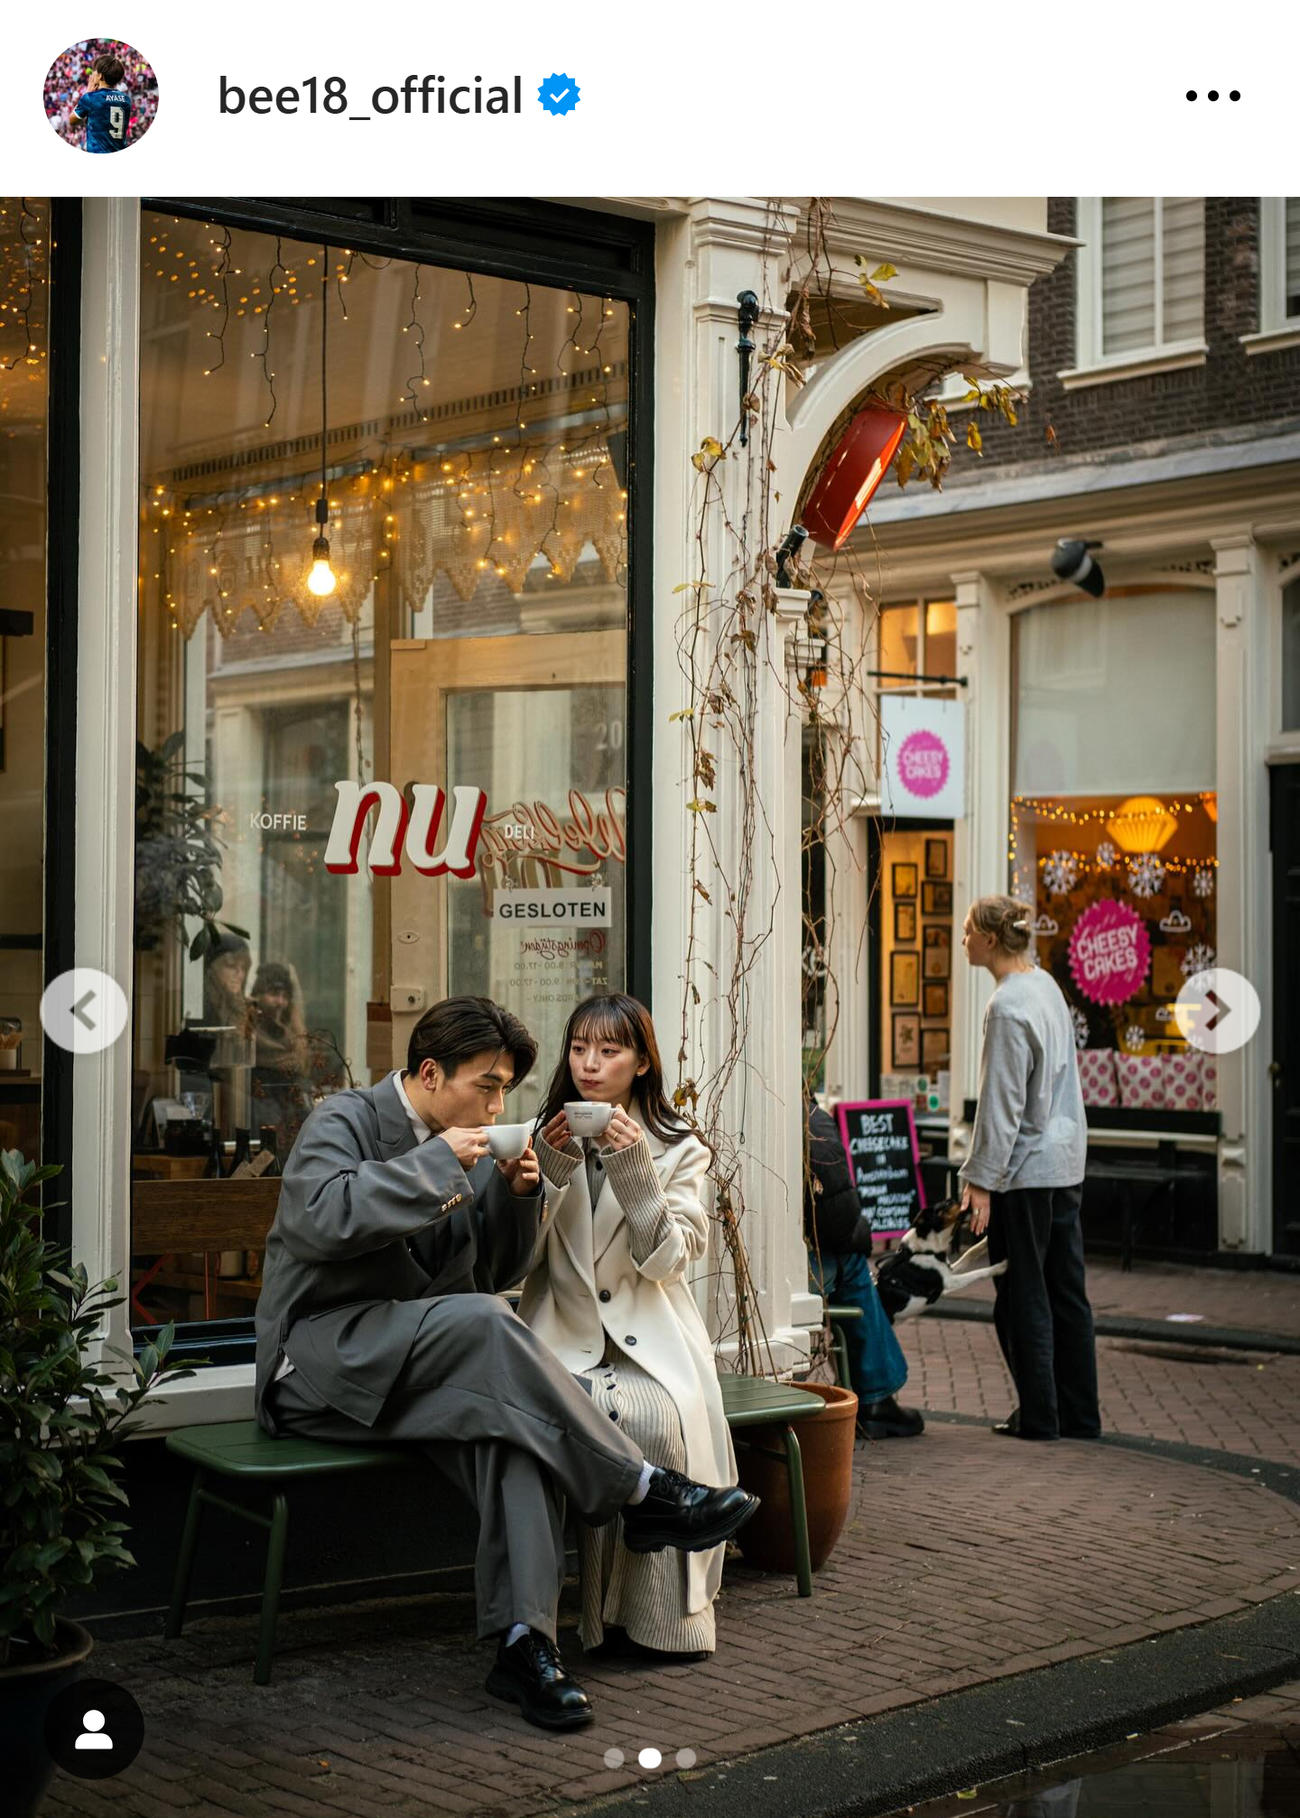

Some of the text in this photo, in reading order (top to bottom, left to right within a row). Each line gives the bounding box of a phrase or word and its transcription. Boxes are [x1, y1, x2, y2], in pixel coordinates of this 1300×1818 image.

[105, 95, 126, 103] AYASE
[109, 106, 125, 139] 9
[250, 812, 308, 832] KOFFIE
[324, 780, 488, 880] nu
[504, 823, 536, 841] DELI
[499, 902, 606, 919] GESLOTEN
[1077, 922, 1139, 961] CHEESY
[1083, 946, 1139, 981] CAKES
[861, 1113, 894, 1137] BEST
